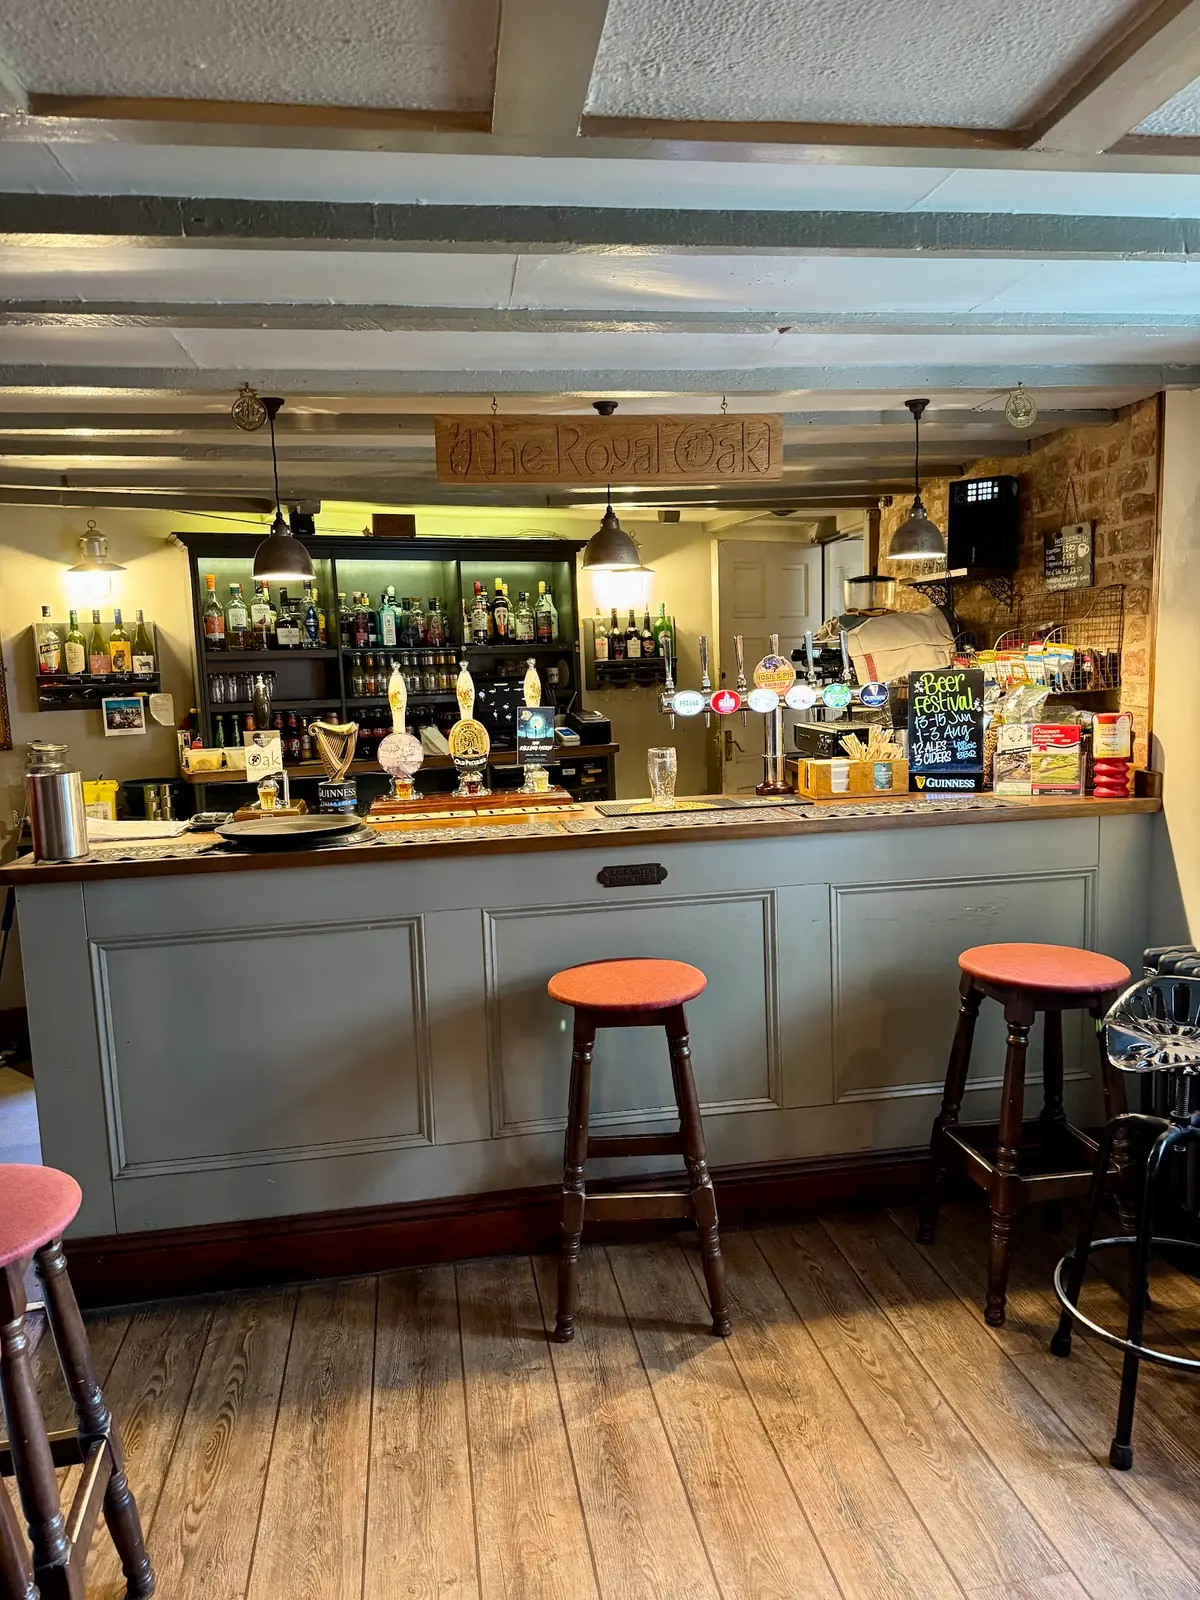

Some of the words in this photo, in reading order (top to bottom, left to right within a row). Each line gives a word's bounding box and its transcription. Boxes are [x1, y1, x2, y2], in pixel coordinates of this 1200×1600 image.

[450, 423, 547, 479] The
[554, 423, 660, 477] Royal
[674, 423, 771, 474] Oak
[783, 671, 794, 680] PIG
[920, 672, 966, 696] Beer
[913, 686, 976, 716] Festival
[914, 712, 947, 730] 13-15
[948, 710, 976, 725] Jun
[916, 727, 940, 743] 1-3
[943, 725, 975, 741] Aug
[911, 742, 925, 755] 12
[925, 740, 947, 753] ALES
[914, 754, 923, 766] 3
[923, 750, 952, 765] CIDERS
[926, 777, 976, 788] GUINNESS
[319, 787, 356, 799] GUINNESS
